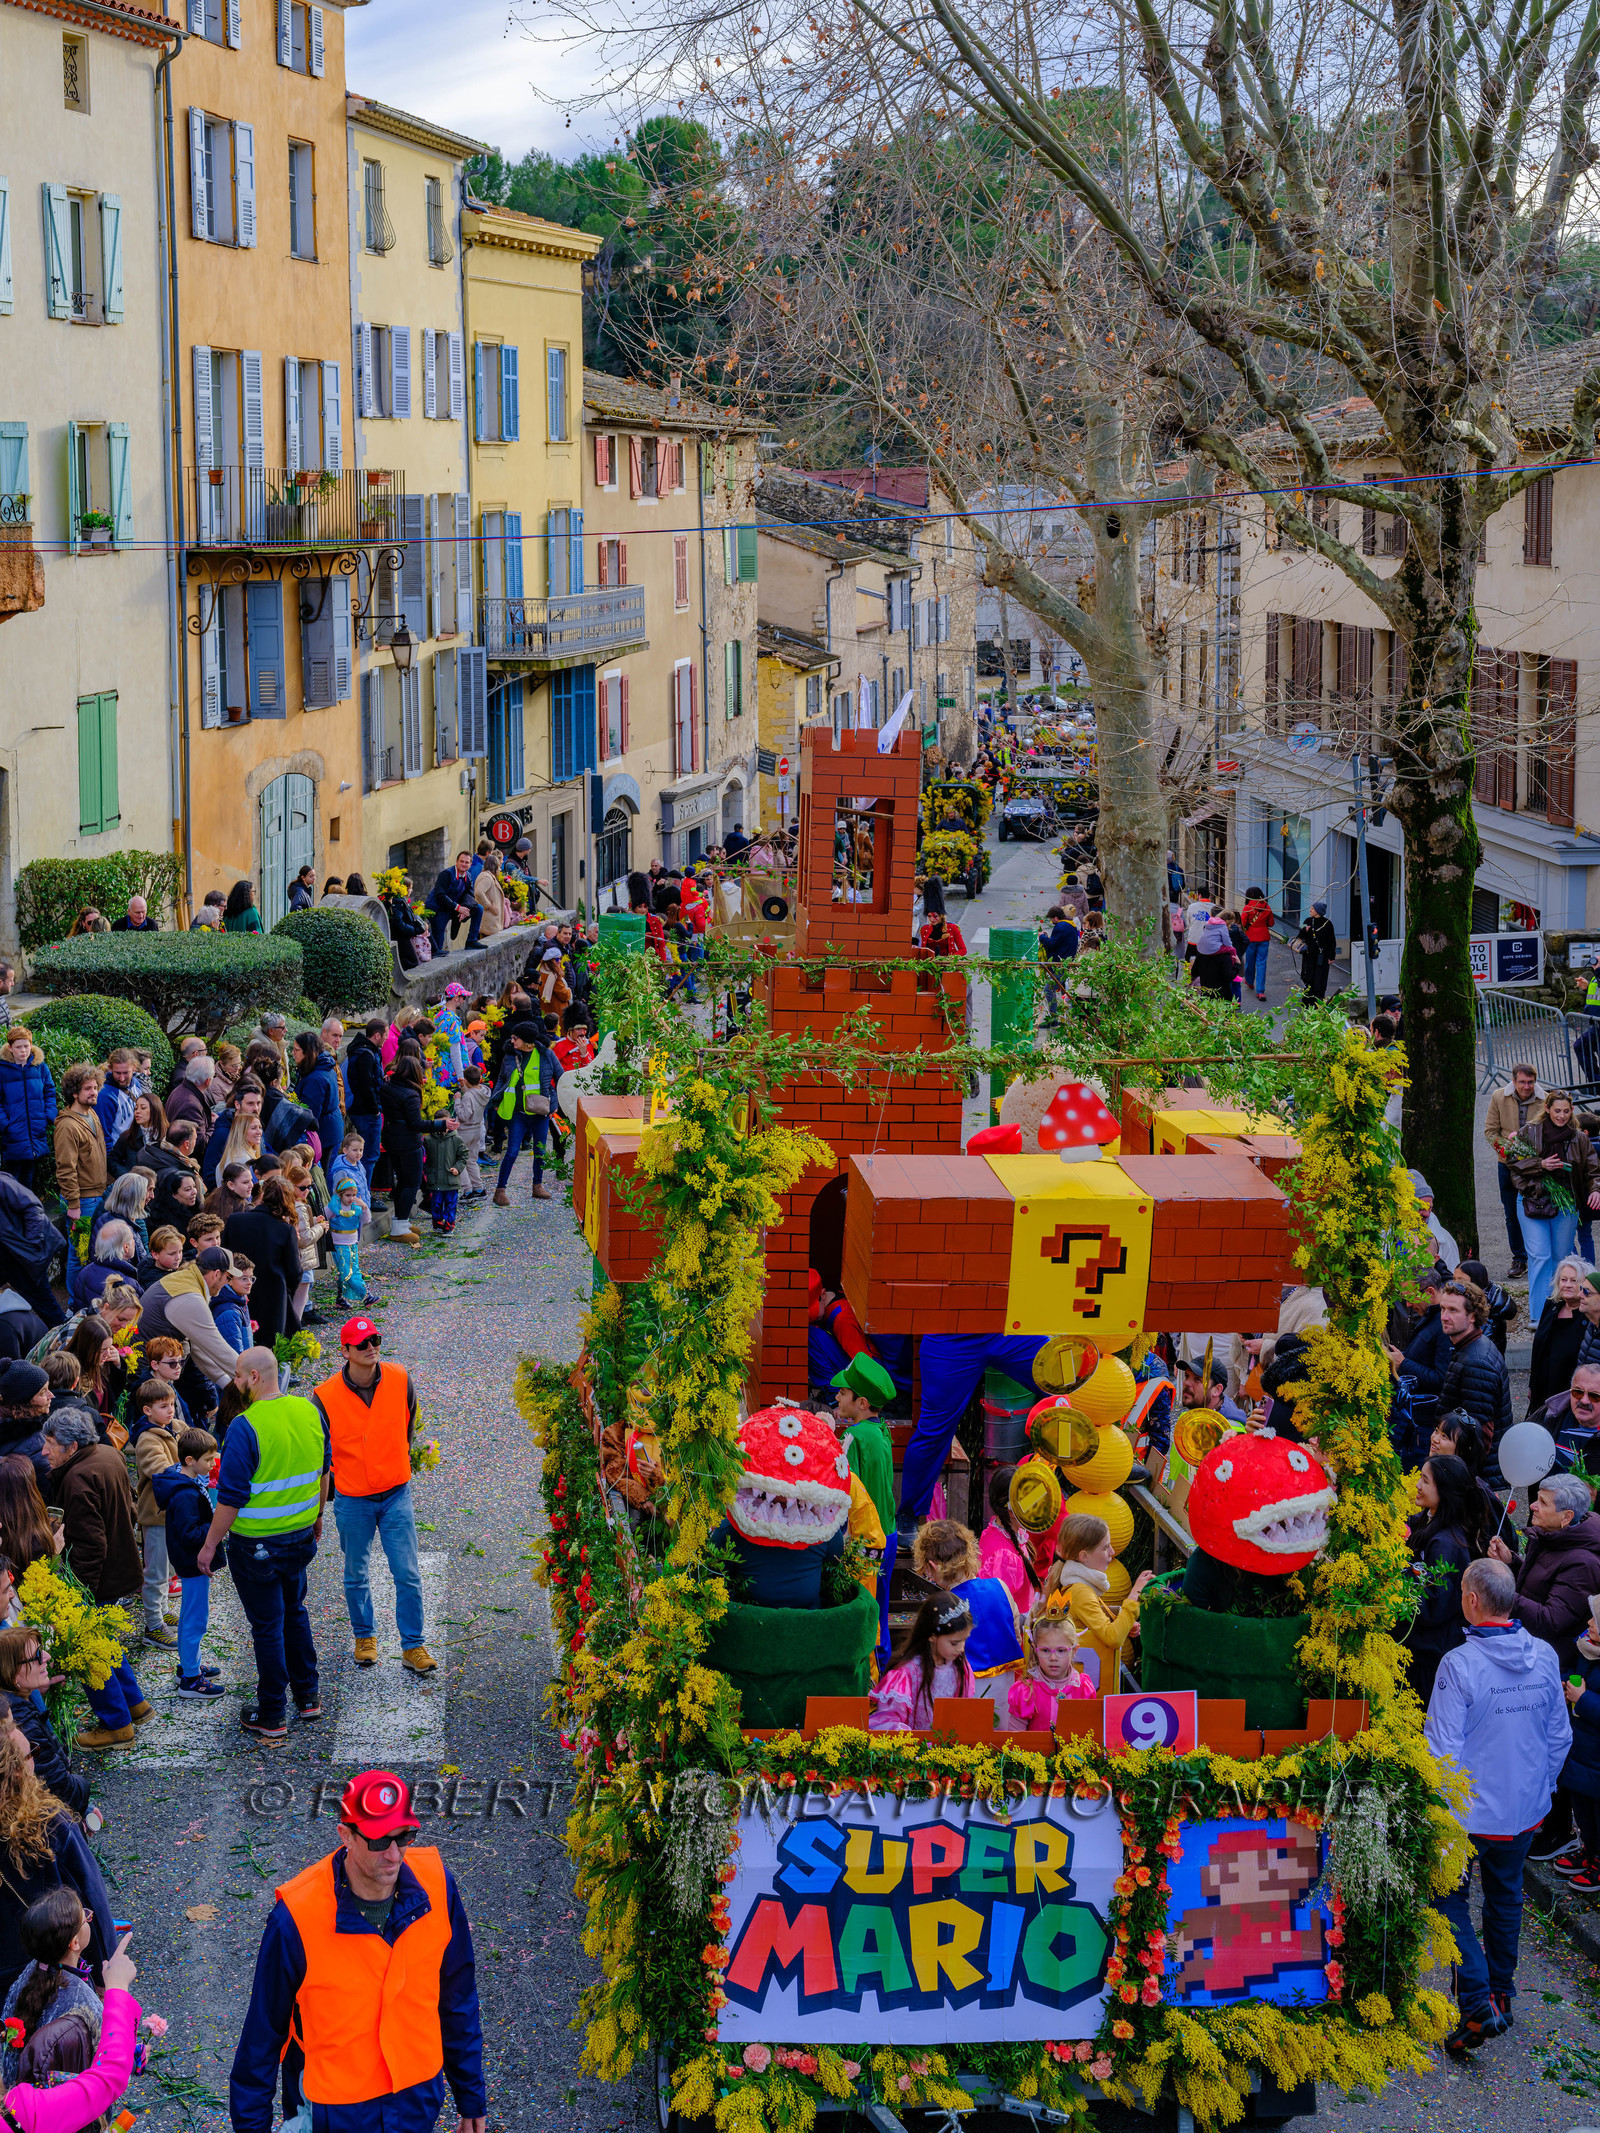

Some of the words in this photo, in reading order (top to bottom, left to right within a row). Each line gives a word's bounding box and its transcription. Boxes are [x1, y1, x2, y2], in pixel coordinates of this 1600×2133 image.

[492, 815, 515, 824] BARNES
[498, 823, 510, 839] B
[1490, 1686, 1517, 1694] Réserve
[1505, 1704, 1531, 1713] Sécurité
[1130, 1702, 1168, 1751] 9
[383, 1791, 395, 1801] M
[777, 1817, 1073, 1896] SUPER
[726, 1898, 1109, 1999] MARIO
